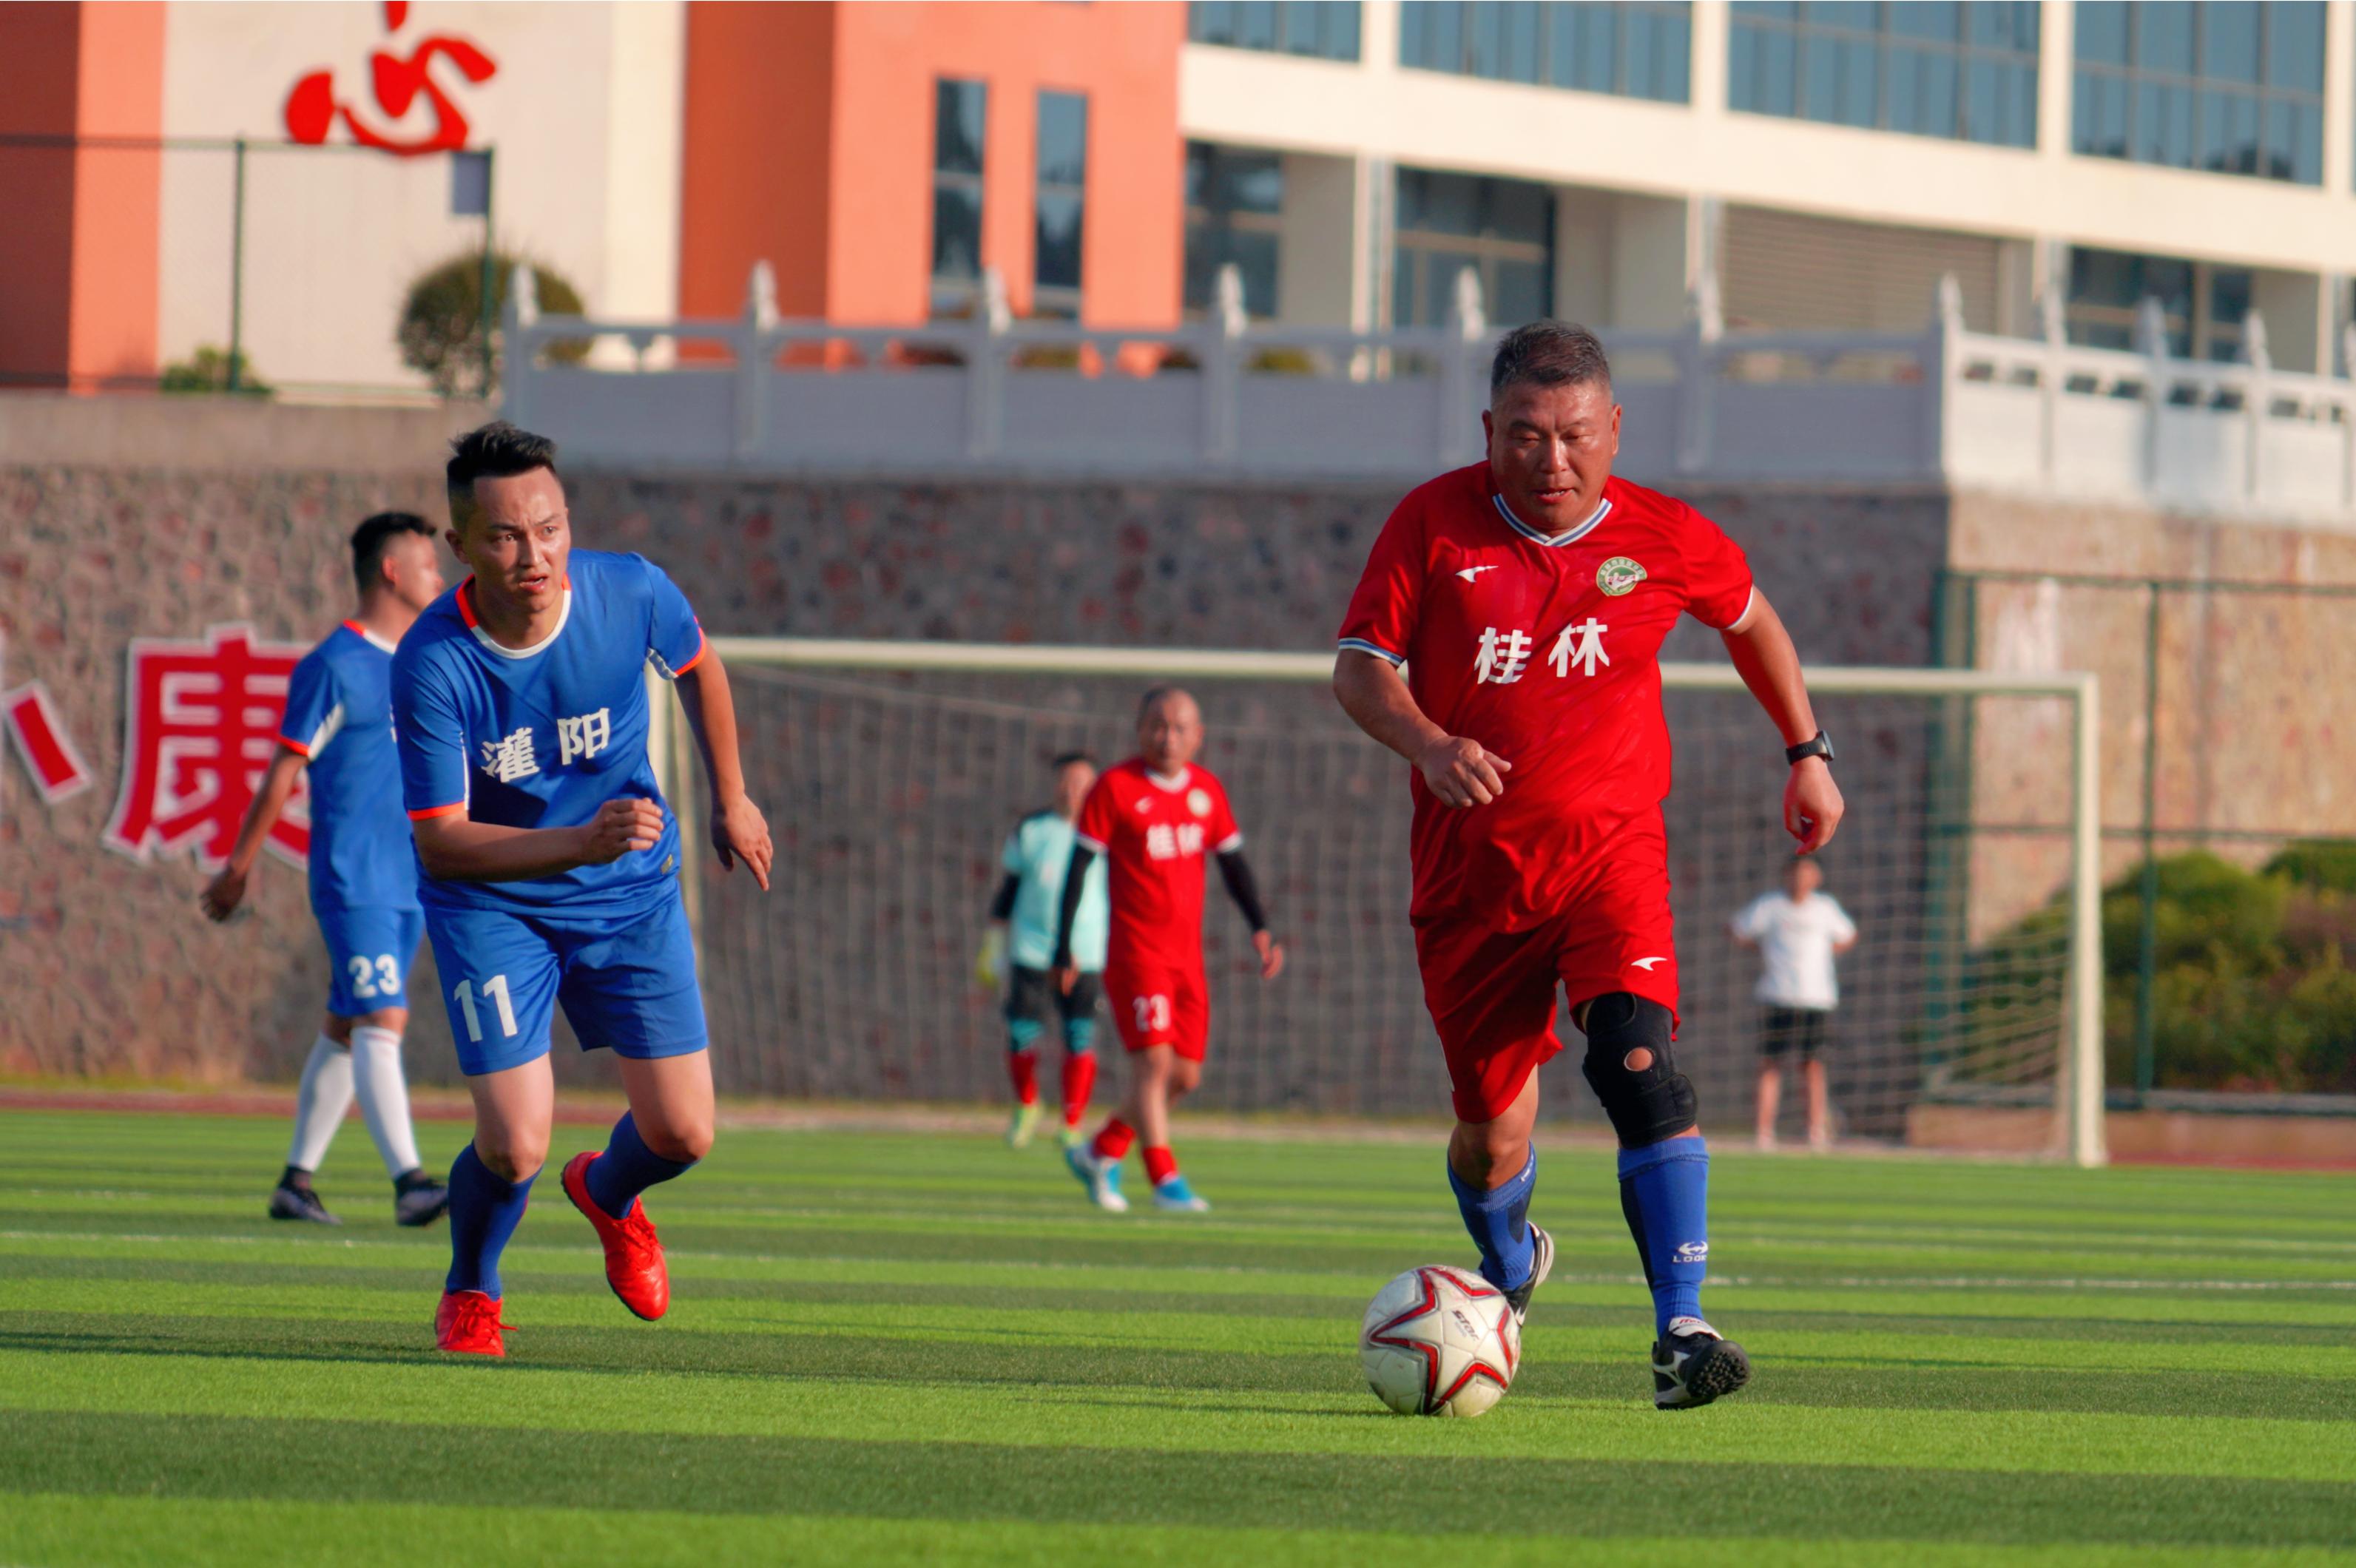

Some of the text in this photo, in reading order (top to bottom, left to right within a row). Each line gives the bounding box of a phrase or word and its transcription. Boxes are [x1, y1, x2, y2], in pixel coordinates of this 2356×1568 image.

[1474, 617, 1610, 684] 桂林
[0, 621, 311, 873] 康
[481, 707, 610, 783] 灌阳
[348, 953, 402, 998] 23
[453, 974, 518, 1042] 11
